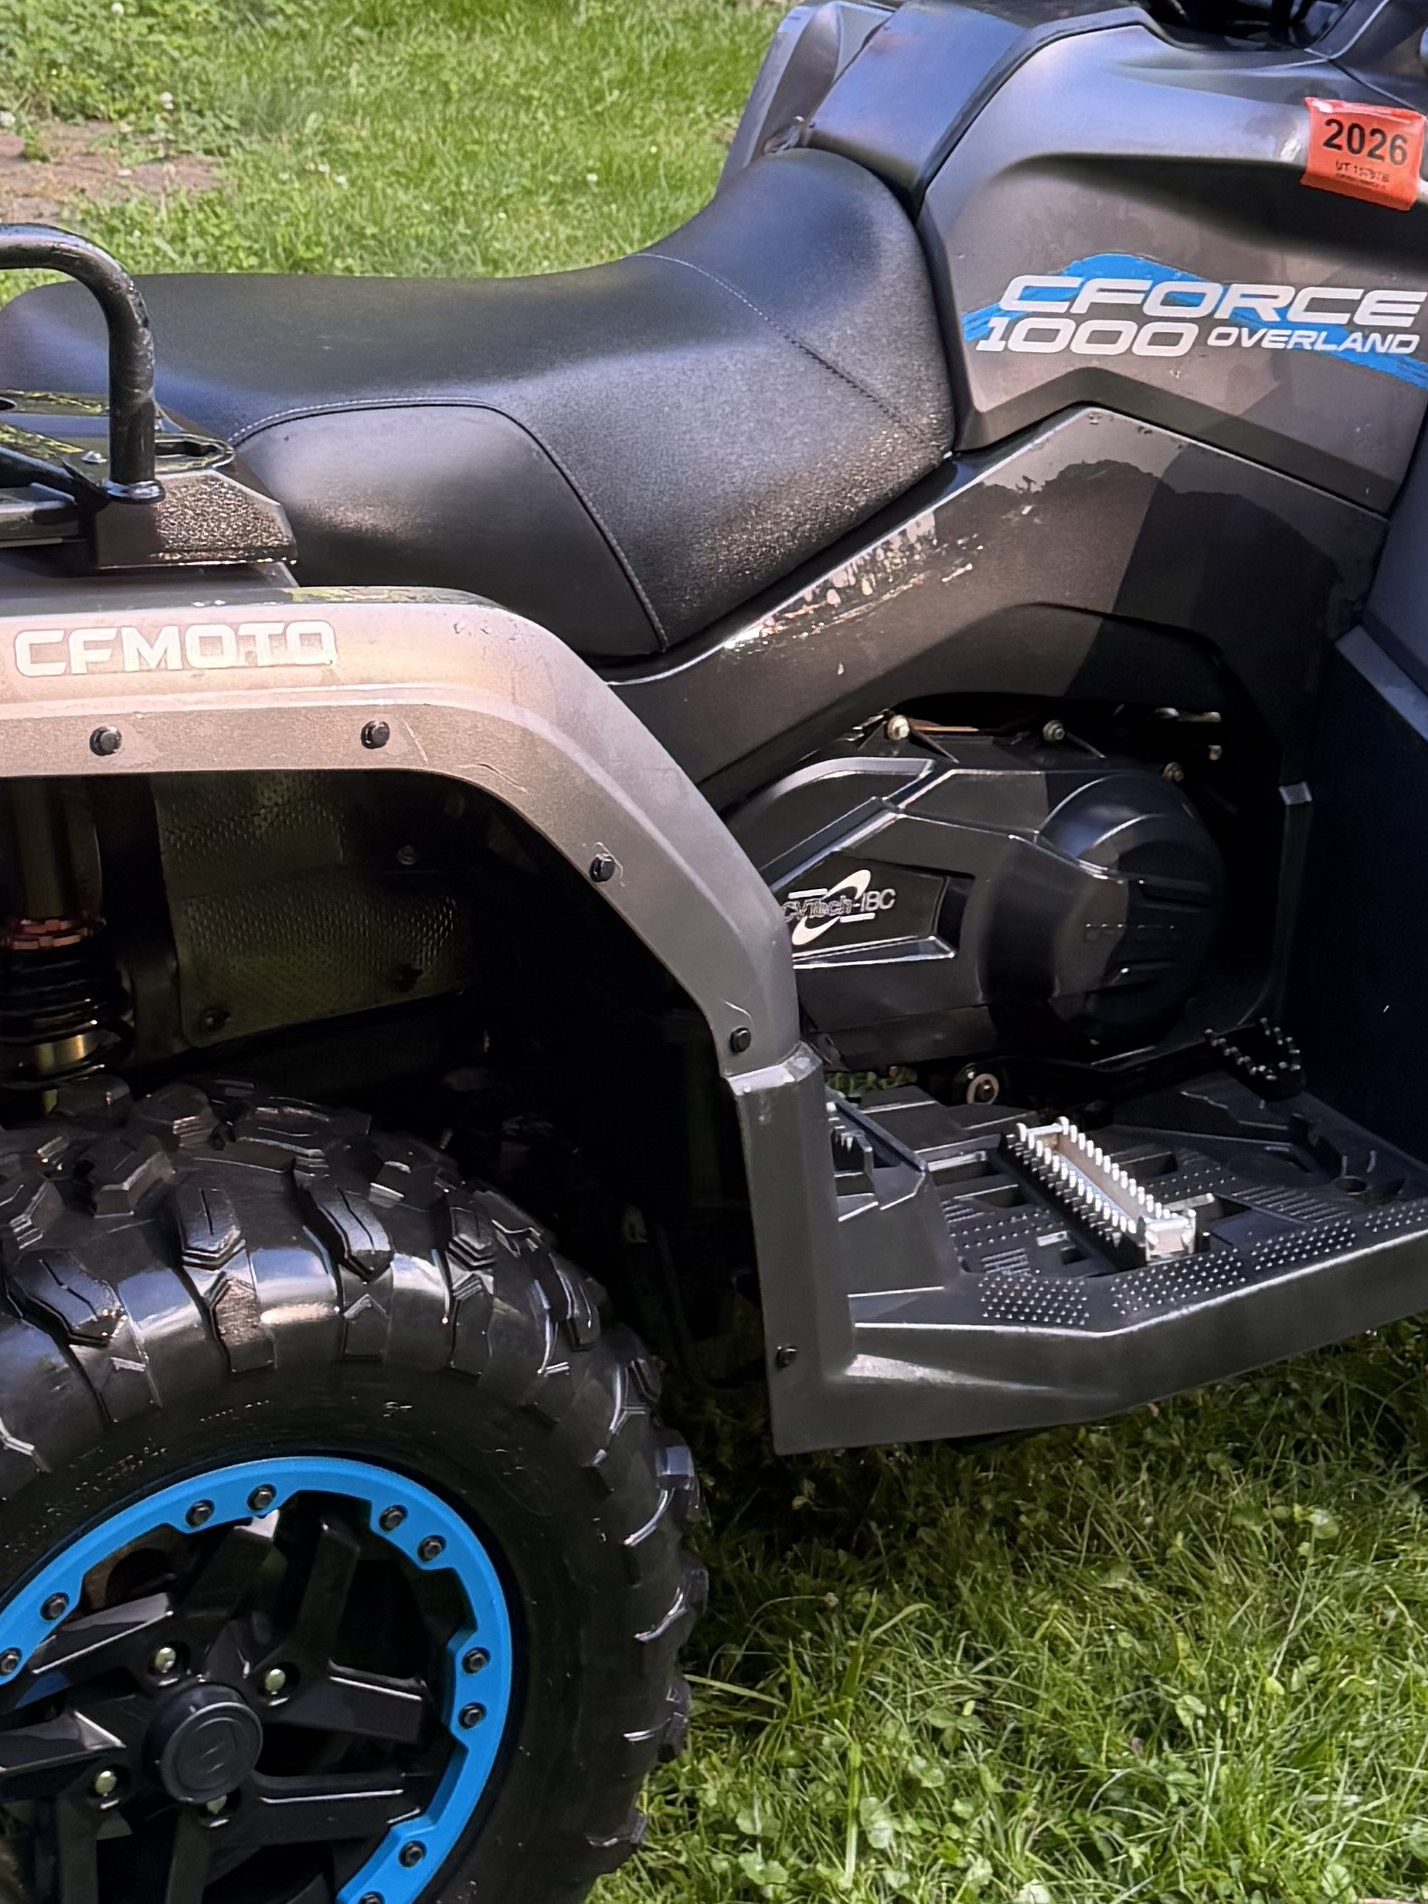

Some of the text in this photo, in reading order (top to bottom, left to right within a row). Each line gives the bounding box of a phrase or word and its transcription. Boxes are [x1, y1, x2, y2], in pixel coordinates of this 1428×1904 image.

[1323, 118, 1408, 166] 2026
[999, 274, 1428, 327] CFORCE
[975, 316, 1420, 357] 1000 OVERLAND
[14, 620, 339, 678] CFMOTO
